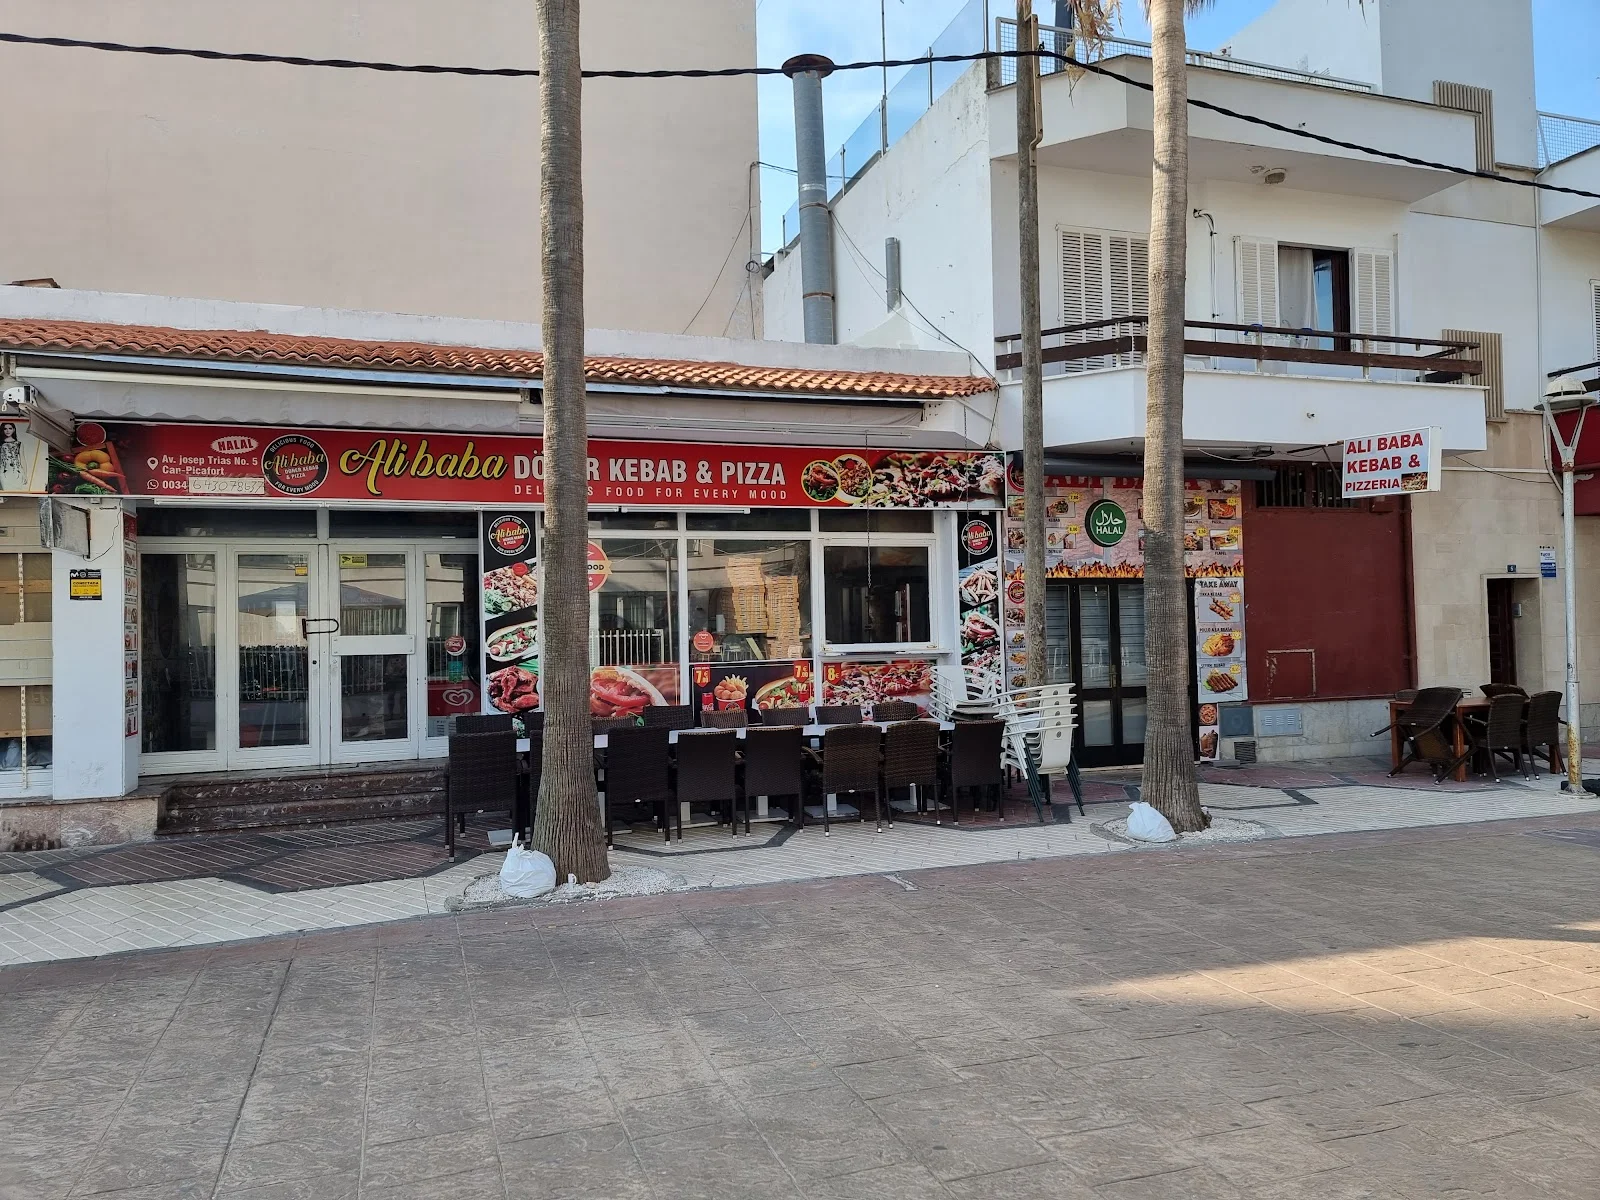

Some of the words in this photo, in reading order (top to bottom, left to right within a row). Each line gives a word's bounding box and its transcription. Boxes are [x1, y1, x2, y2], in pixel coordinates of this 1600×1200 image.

[217, 438, 254, 452] HALAL
[269, 437, 297, 453] DELICIOUS
[299, 438, 315, 449] FOOD
[1346, 439, 1371, 454] ALI
[1377, 432, 1424, 451] BABA
[162, 454, 176, 464] Av.
[180, 455, 205, 466] josep
[207, 455, 232, 465] Trias
[234, 456, 250, 466] No.
[252, 457, 258, 466] 5
[1347, 456, 1402, 474] KEBAB
[1408, 454, 1420, 468] &
[302, 464, 319, 472] KEBAB
[609, 458, 687, 483] KEBAB
[695, 460, 713, 484] &
[721, 461, 786, 485] PIZZA
[162, 480, 188, 490] 0034
[274, 480, 286, 491] FOR
[304, 480, 320, 491] MOOD
[1345, 478, 1400, 492] PIZZERIA
[605, 486, 644, 497] FOOD
[656, 487, 682, 498] FOR
[693, 488, 738, 499] EVERY
[749, 489, 787, 500] MOOD
[1095, 510, 1123, 526] حلال
[1096, 526, 1123, 535] HALAL
[1200, 580, 1218, 588] TAKE
[1219, 580, 1239, 588] AWAY
